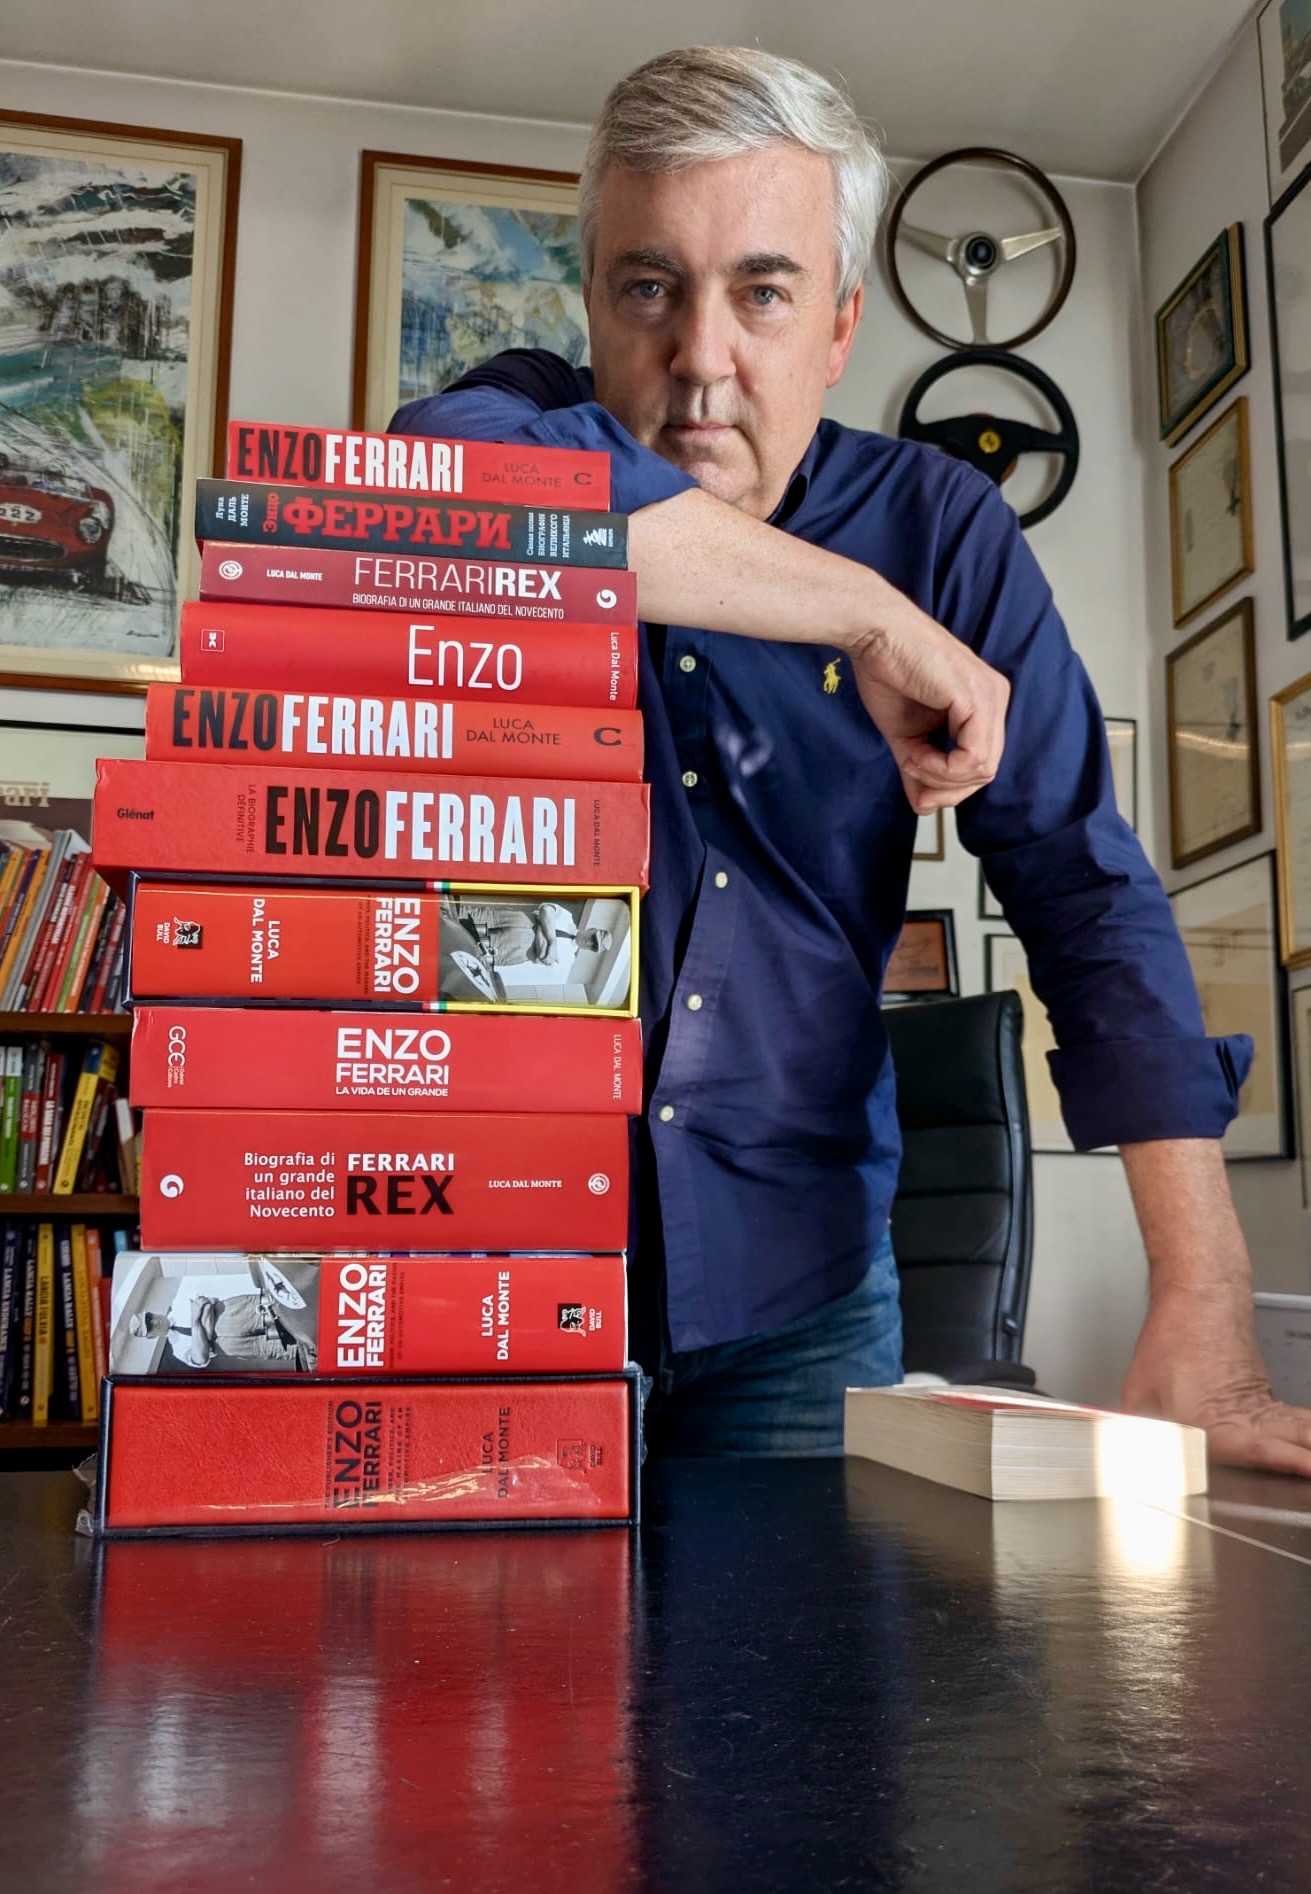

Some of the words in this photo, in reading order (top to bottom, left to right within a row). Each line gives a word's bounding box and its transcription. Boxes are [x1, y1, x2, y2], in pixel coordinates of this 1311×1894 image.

[482, 472, 507, 484] DAL
[512, 475, 561, 488] MONTE
[505, 463, 539, 474] LUCA
[215, 496, 225, 519] Лука
[227, 496, 237, 522] ДАЛЬ
[240, 493, 249, 527] МОНТЕ
[262, 492, 279, 534] Энцо
[282, 496, 513, 550] ФЕРРАРИ
[538, 513, 546, 556] БИОГРАФИЯ
[549, 513, 558, 557] ВЕЛИКОГО
[266, 568, 284, 578] LUCA
[286, 570, 298, 579] DAL
[300, 572, 323, 581] MONTE
[352, 593, 397, 607] BIOGRAFIA
[399, 596, 408, 608] DI
[409, 596, 421, 608] UN
[422, 598, 456, 611] GRANDE
[458, 601, 496, 614] ITALIANO
[498, 604, 513, 616] DEL
[515, 605, 564, 619] NOVECENTO
[610, 632, 620, 650] Luca
[408, 624, 523, 691] Enzo
[611, 652, 620, 668] Dal
[609, 670, 620, 701] Monte
[466, 730, 496, 743] DAL
[502, 732, 561, 745] MONTE
[493, 718, 534, 730] LUCA
[0, 782, 50, 807] ari
[248, 784, 256, 795] LA
[117, 808, 154, 820] Glénat
[247, 797, 256, 854] BIOGRAPHIE
[252, 898, 265, 926] DAL
[267, 920, 280, 960] LUCA
[374, 897, 392, 992] FERRARI
[392, 897, 421, 994] ENZO
[250, 930, 264, 983] MONTE
[337, 1028, 451, 1061] ENZO
[613, 1034, 622, 1054] LUCA
[336, 1063, 449, 1085] FERRARI
[613, 1057, 622, 1071] DAL
[336, 1087, 350, 1095] LA
[351, 1087, 375, 1096] VIDA
[376, 1087, 390, 1096] DE
[391, 1087, 406, 1096] UN
[407, 1088, 448, 1097] GRANDE
[613, 1073, 622, 1101] MONTE
[244, 1152, 315, 1168] Biografia
[320, 1152, 335, 1166] di
[347, 1153, 454, 1171] FERRARI
[254, 1172, 273, 1183] un
[279, 1170, 335, 1186] grande
[488, 1180, 511, 1188] LUCA
[512, 1180, 529, 1188] DAL
[531, 1180, 562, 1188] MONTE
[246, 1187, 305, 1201] italiano
[311, 1186, 334, 1200] del
[346, 1174, 454, 1216] REX
[250, 1204, 335, 1218] Novecento
[497, 1271, 510, 1325] MONTE
[337, 1263, 368, 1367] ENZO
[366, 1264, 387, 1367] FERRARI
[481, 1295, 494, 1336] LUCA
[497, 1330, 509, 1360] DAL
[498, 1407, 510, 1462] MONTE
[333, 1400, 362, 1509] ENZO
[482, 1431, 493, 1474] LUCA
[498, 1469, 509, 1498] DAL
